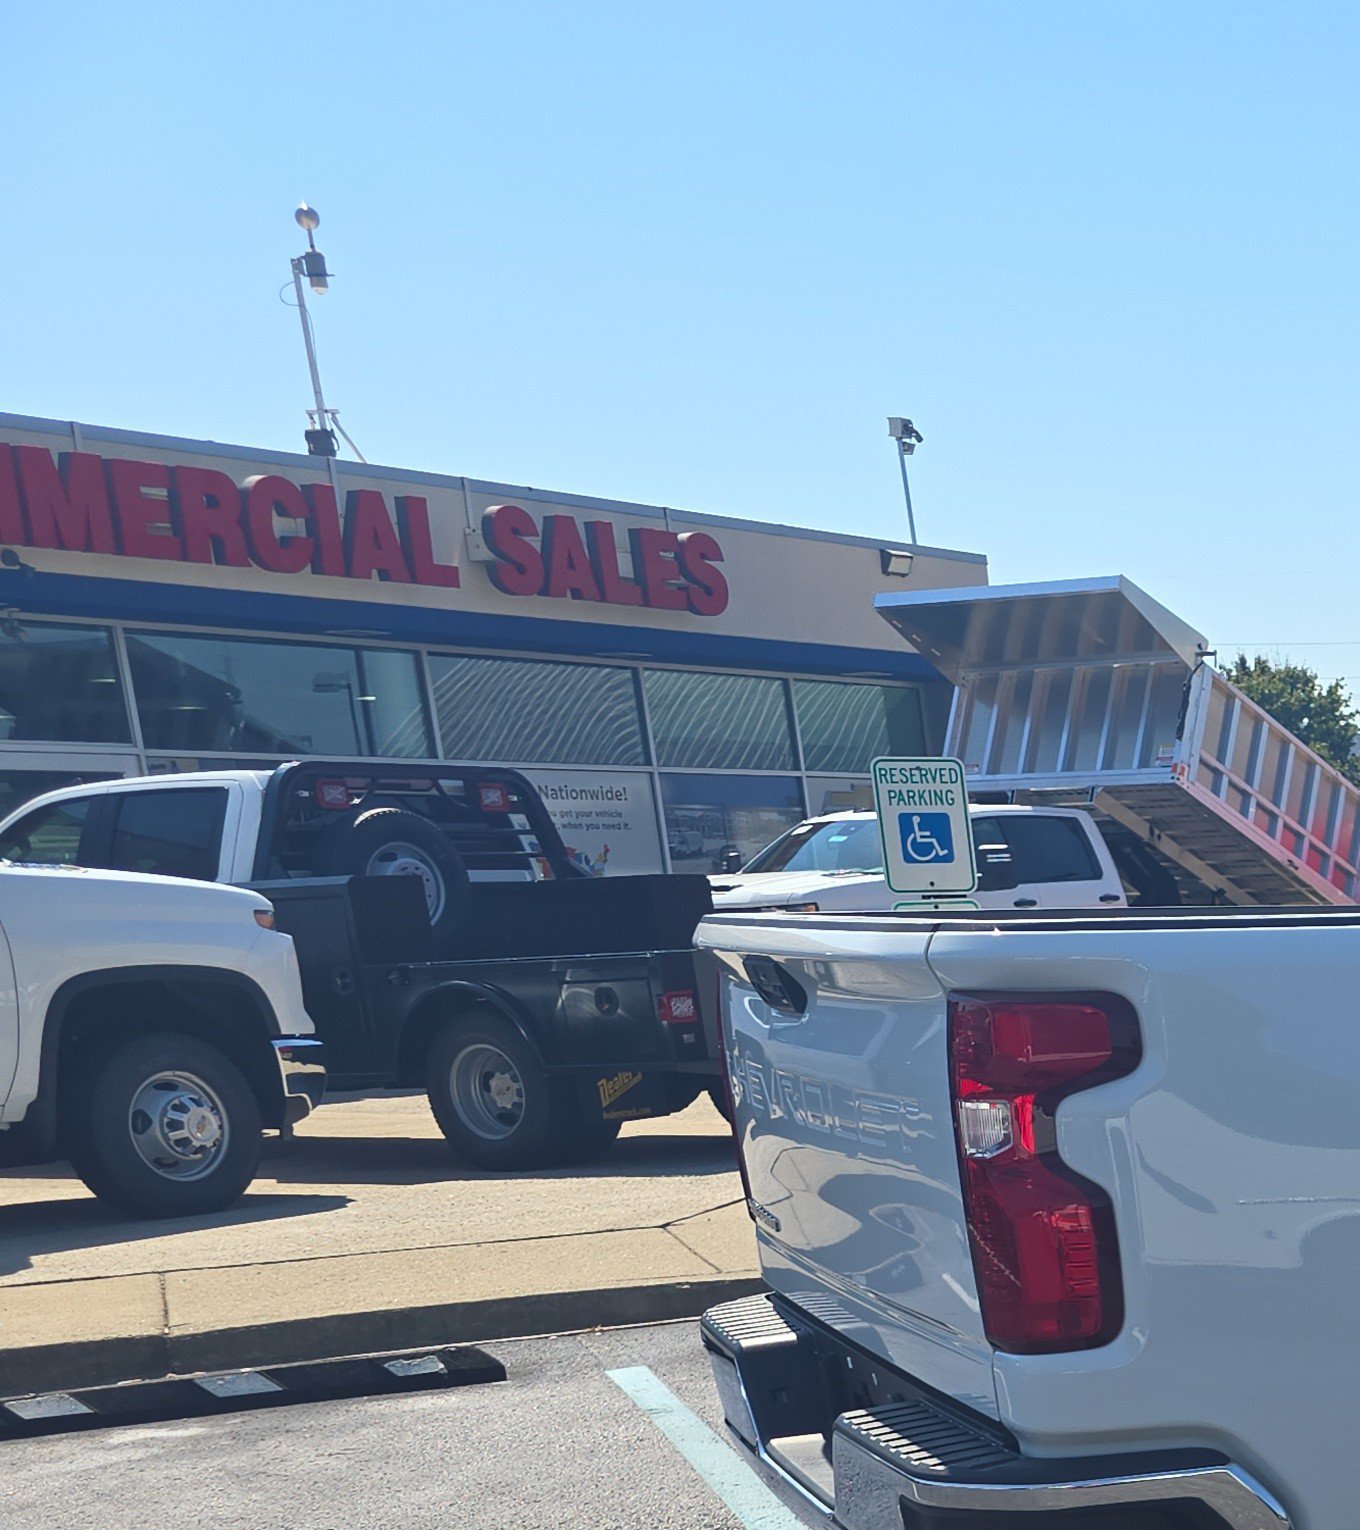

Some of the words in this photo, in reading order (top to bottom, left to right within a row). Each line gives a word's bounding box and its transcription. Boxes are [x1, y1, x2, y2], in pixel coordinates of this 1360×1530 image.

[481, 504, 729, 616] SALES
[878, 767, 959, 785] RESERVED
[537, 784, 629, 802] Nationwide!
[887, 789, 956, 807] PARKING
